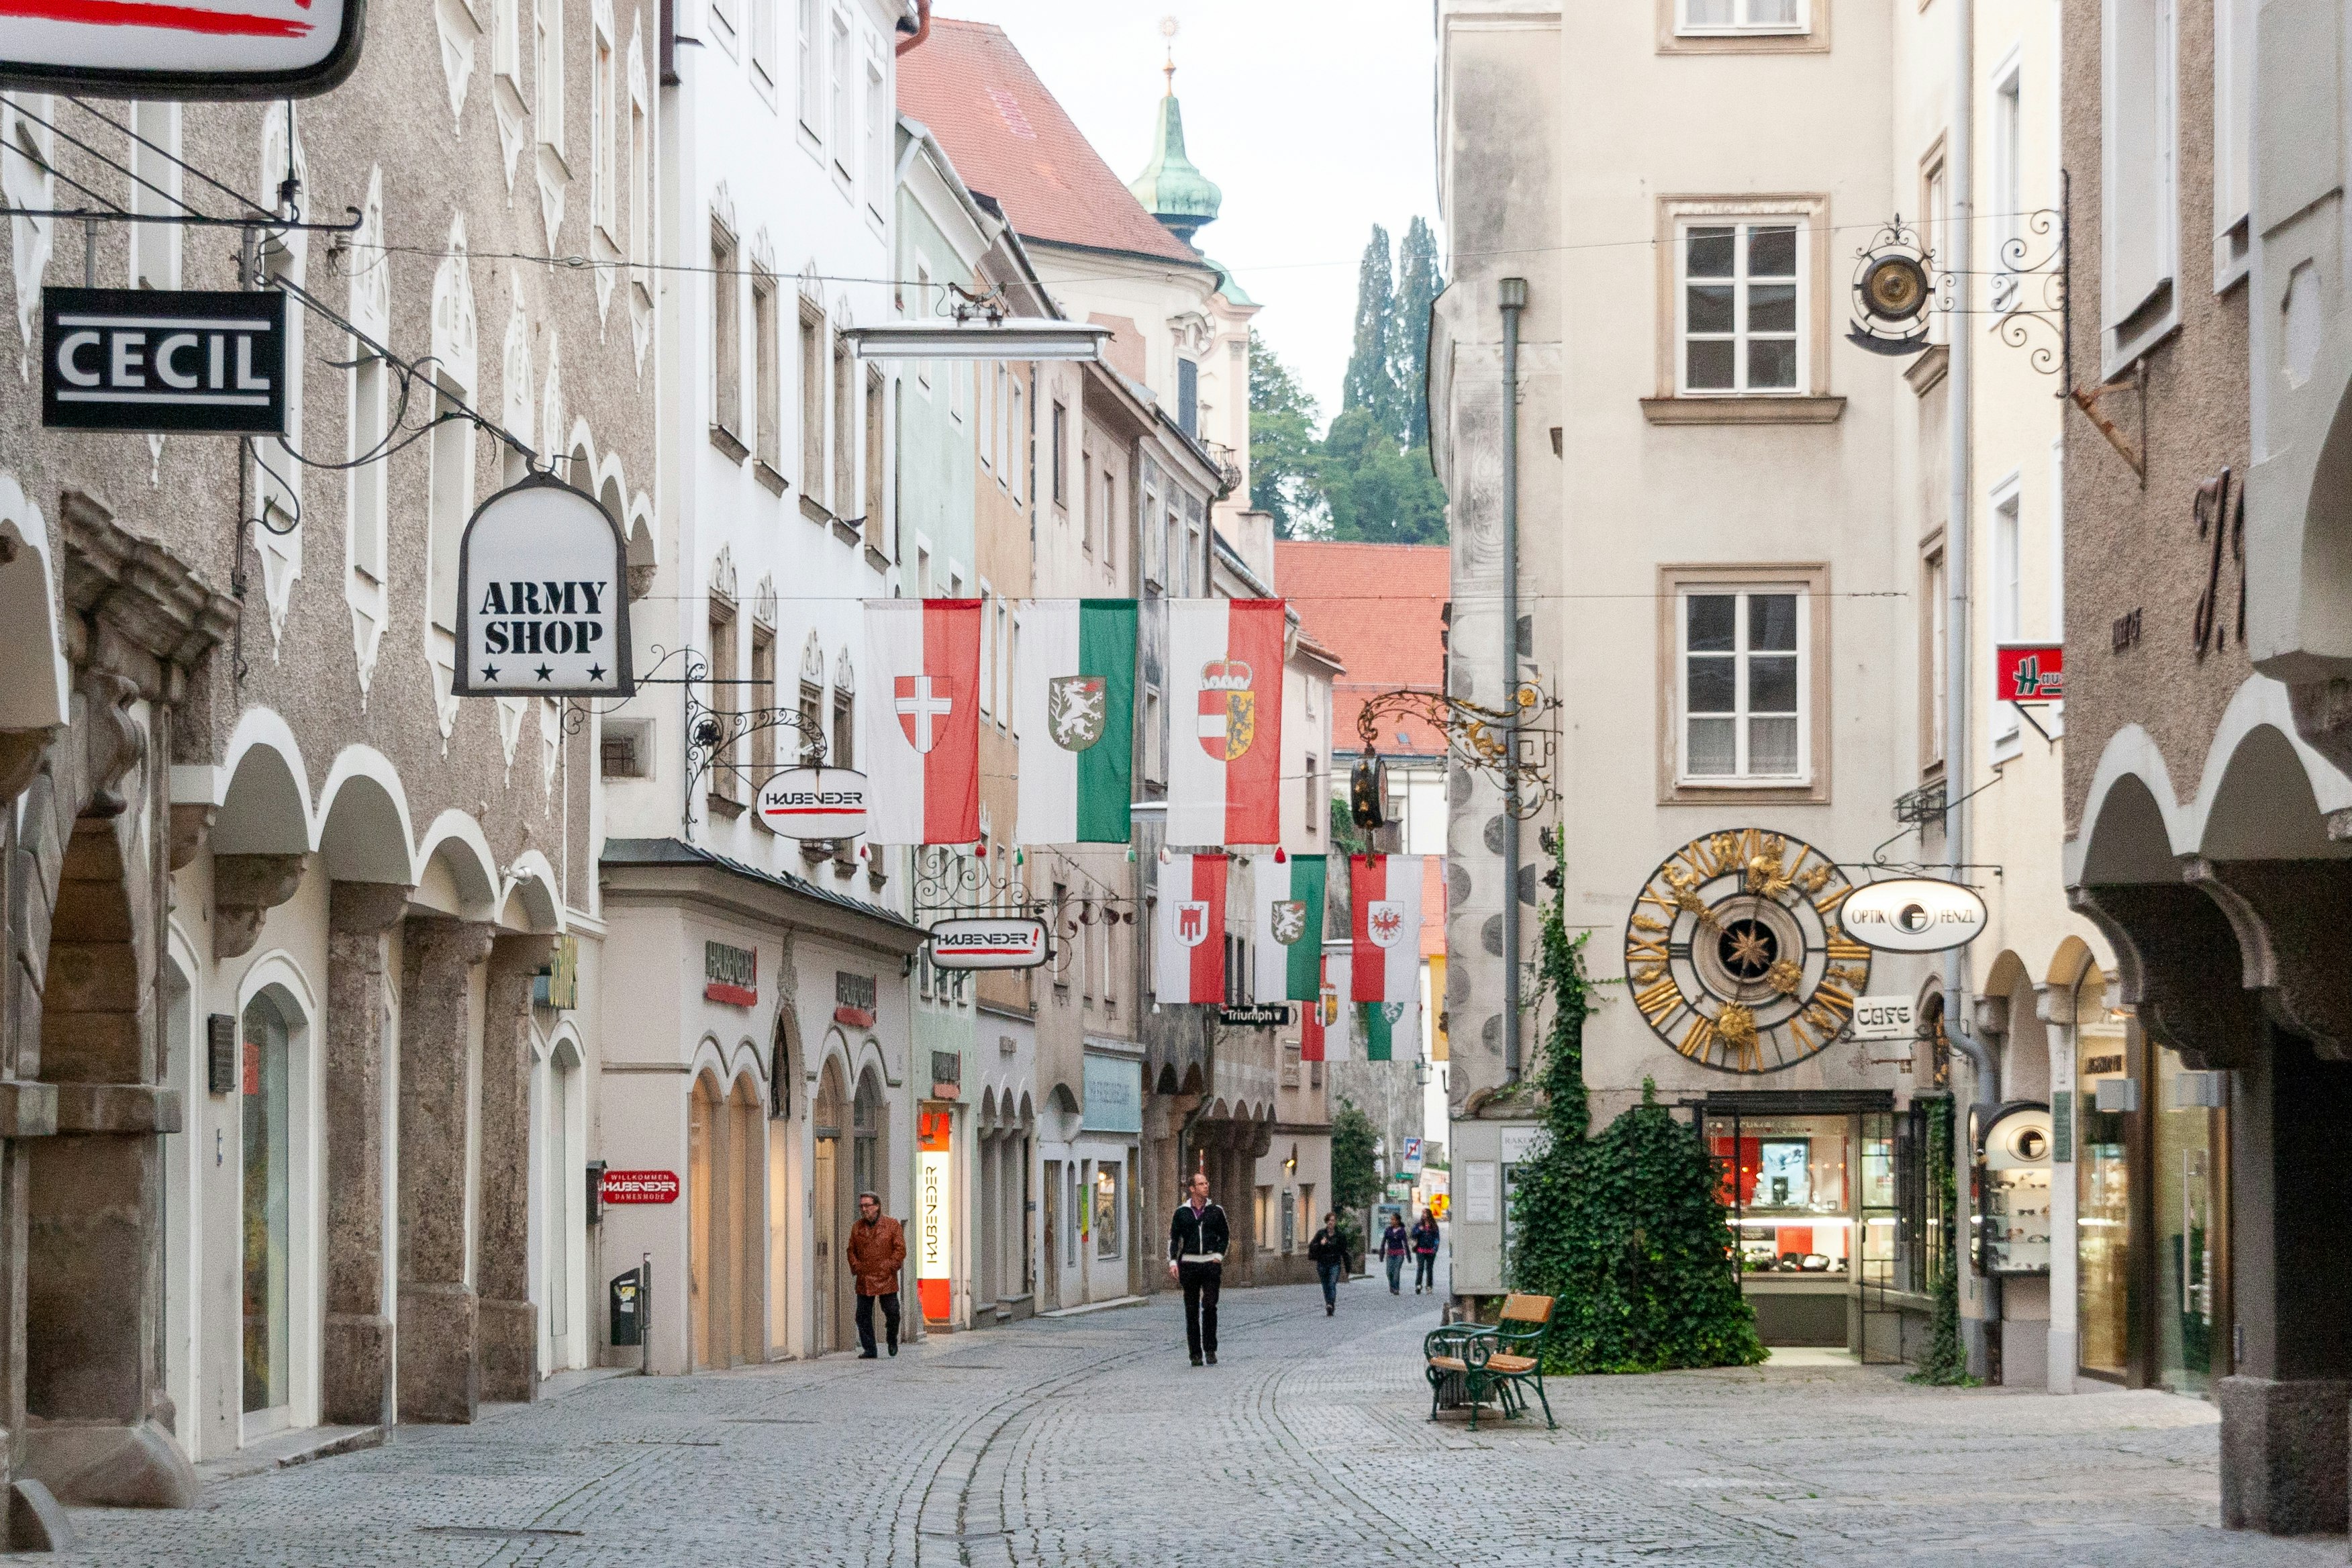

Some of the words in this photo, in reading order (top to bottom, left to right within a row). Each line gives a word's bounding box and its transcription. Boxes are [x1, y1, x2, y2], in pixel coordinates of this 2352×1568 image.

[57, 330, 271, 391] CECIL
[480, 581, 607, 615] ARMY
[485, 621, 603, 654] SHOP
[2013, 655, 2062, 695] Hau
[766, 792, 863, 805] HAUBENEDER
[1852, 910, 1887, 924] OPTIK
[1941, 910, 1975, 924] FENZL
[1227, 1009, 1273, 1023] Triumph
[1857, 1007, 1910, 1026] CAFE
[603, 1181, 676, 1192] HAUBENEDER
[926, 1167, 938, 1263] HAUBENEDER
